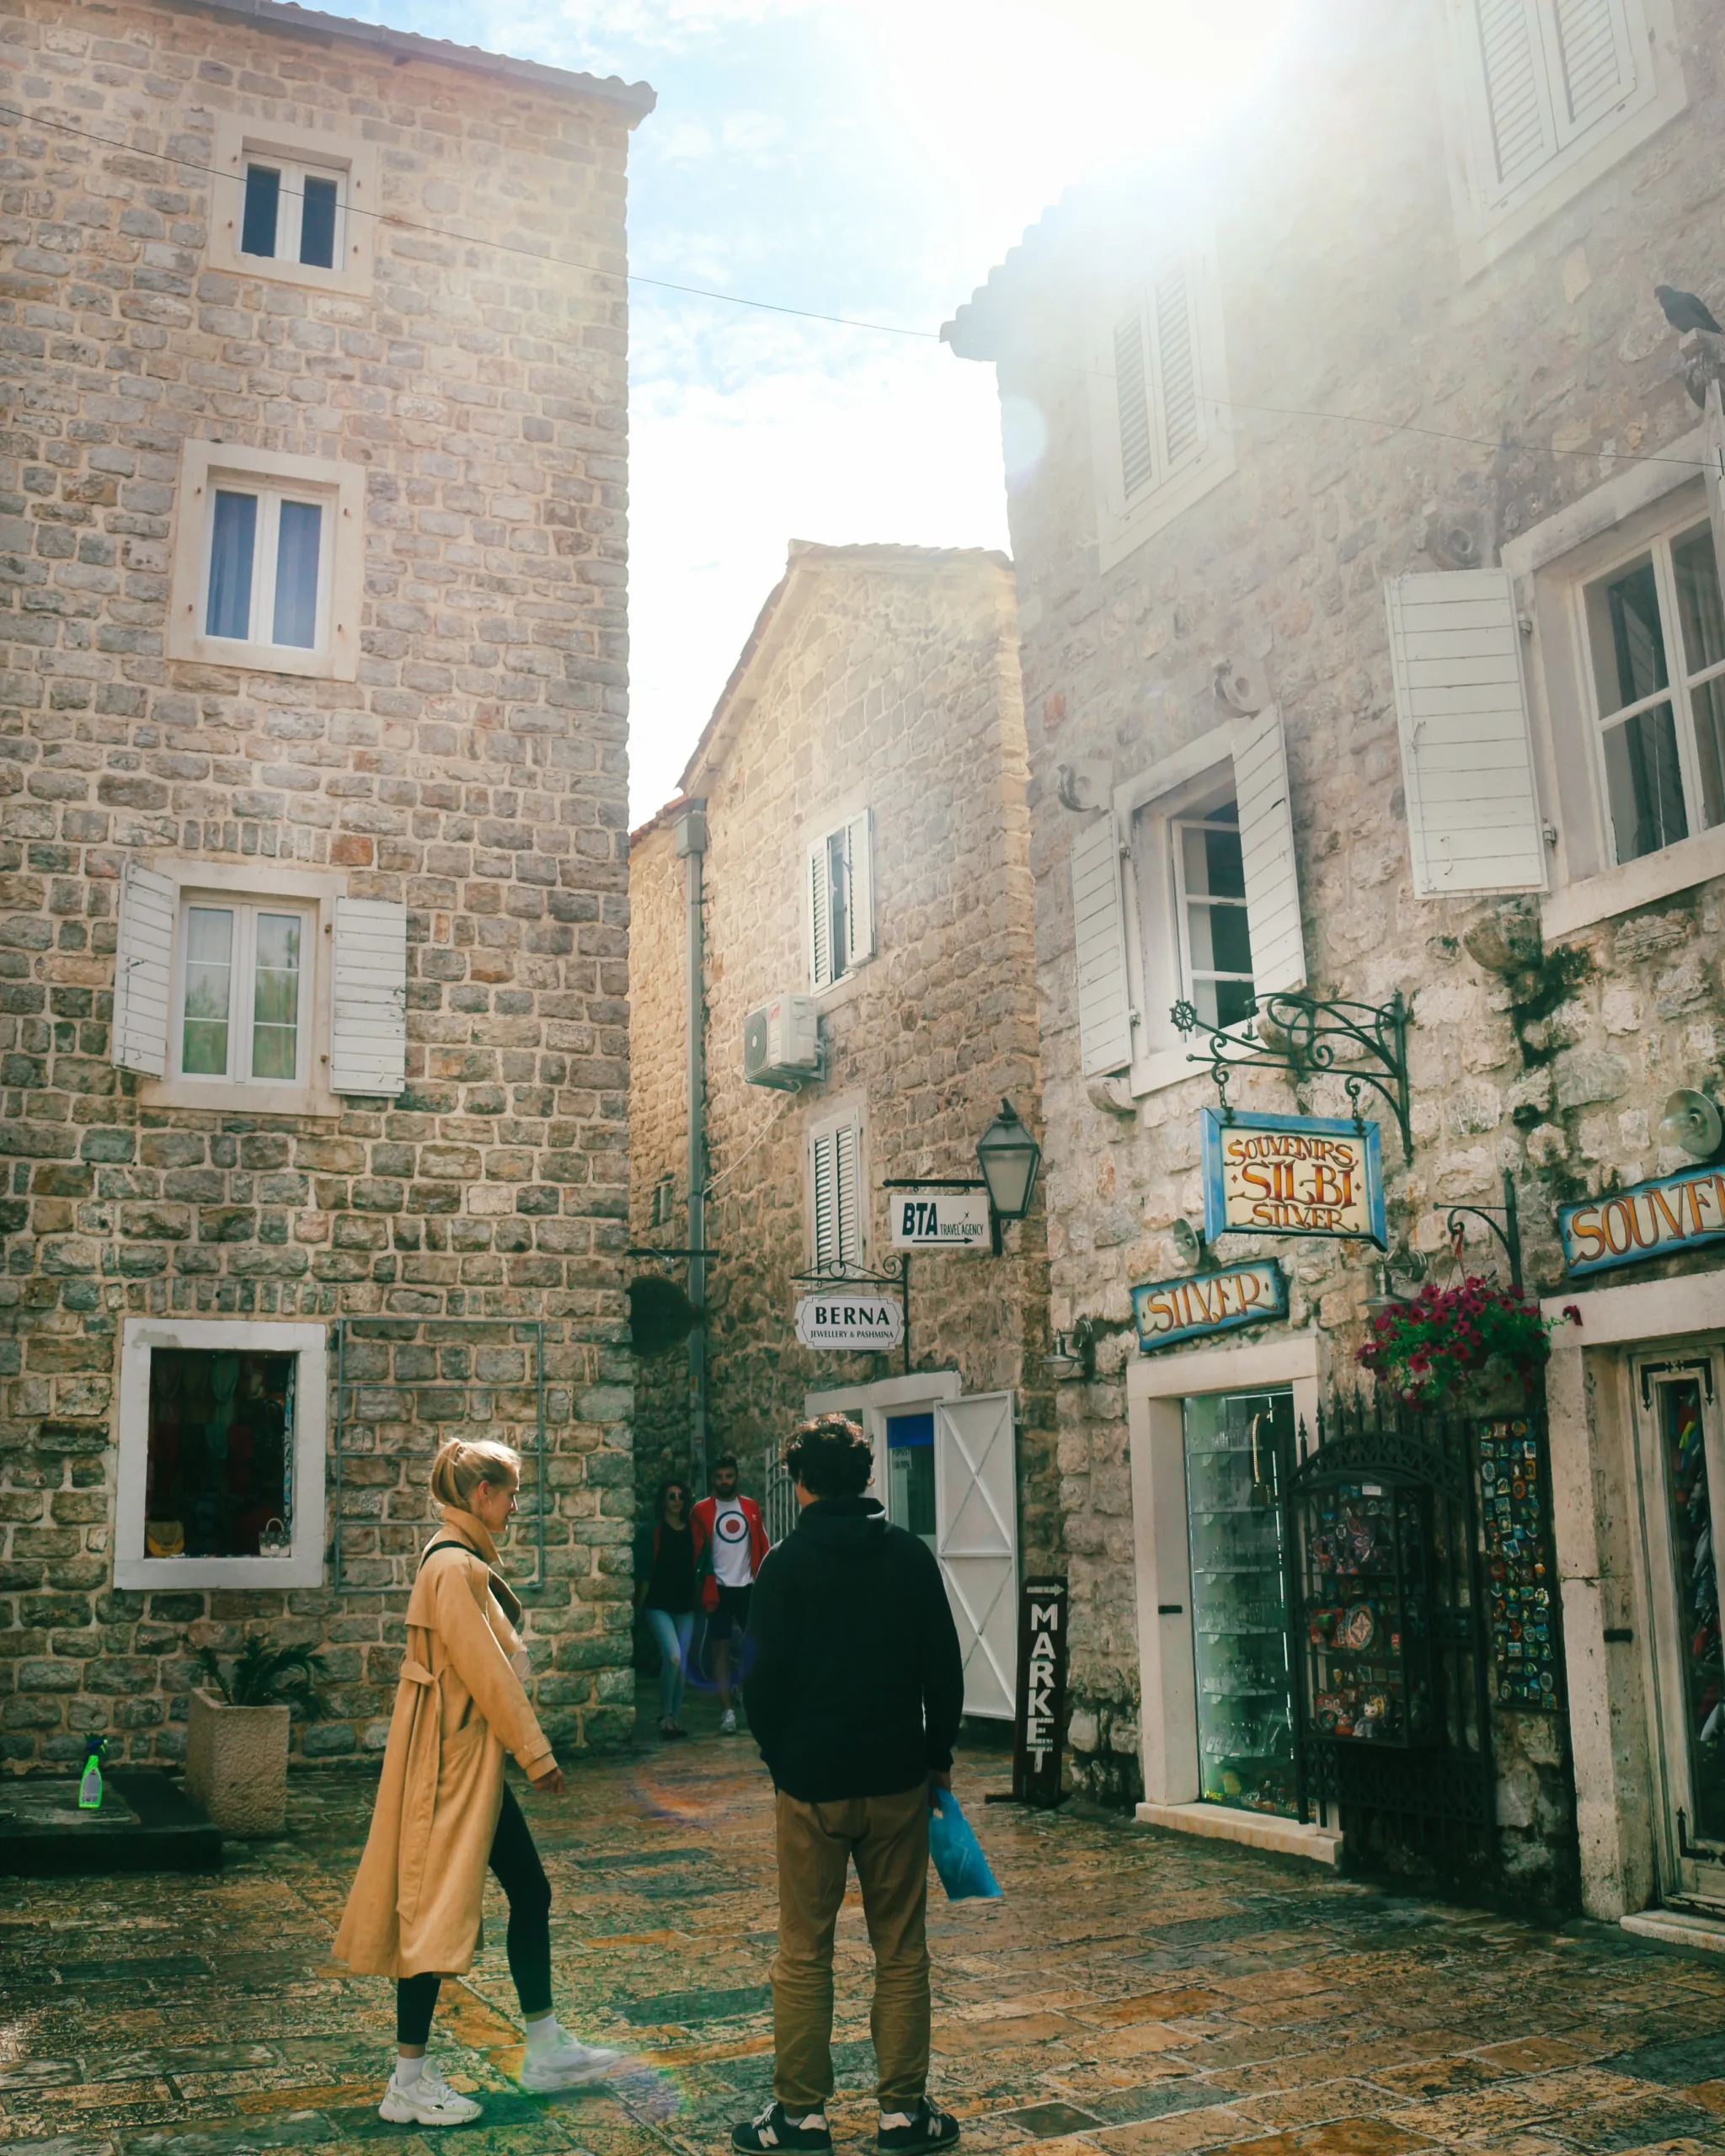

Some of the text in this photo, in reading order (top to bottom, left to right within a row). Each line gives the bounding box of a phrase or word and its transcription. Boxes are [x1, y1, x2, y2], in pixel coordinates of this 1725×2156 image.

[1224, 1134, 1359, 1168] SOUVENIRS
[1227, 1159, 1357, 1209] SILBI
[902, 1202, 938, 1236] BTA
[940, 1224, 984, 1235] TRAVEL AGENCY
[1231, 1203, 1359, 1233] SILVER
[815, 1306, 890, 1326] BERNA
[1141, 1272, 1278, 1336] SILVER
[810, 1330, 848, 1339] JEWELLERY
[857, 1330, 894, 1338] PASHMINA
[1026, 1604, 1059, 1774] MARKET
[758, 2126, 779, 2148] N
[927, 2116, 943, 2137] N
